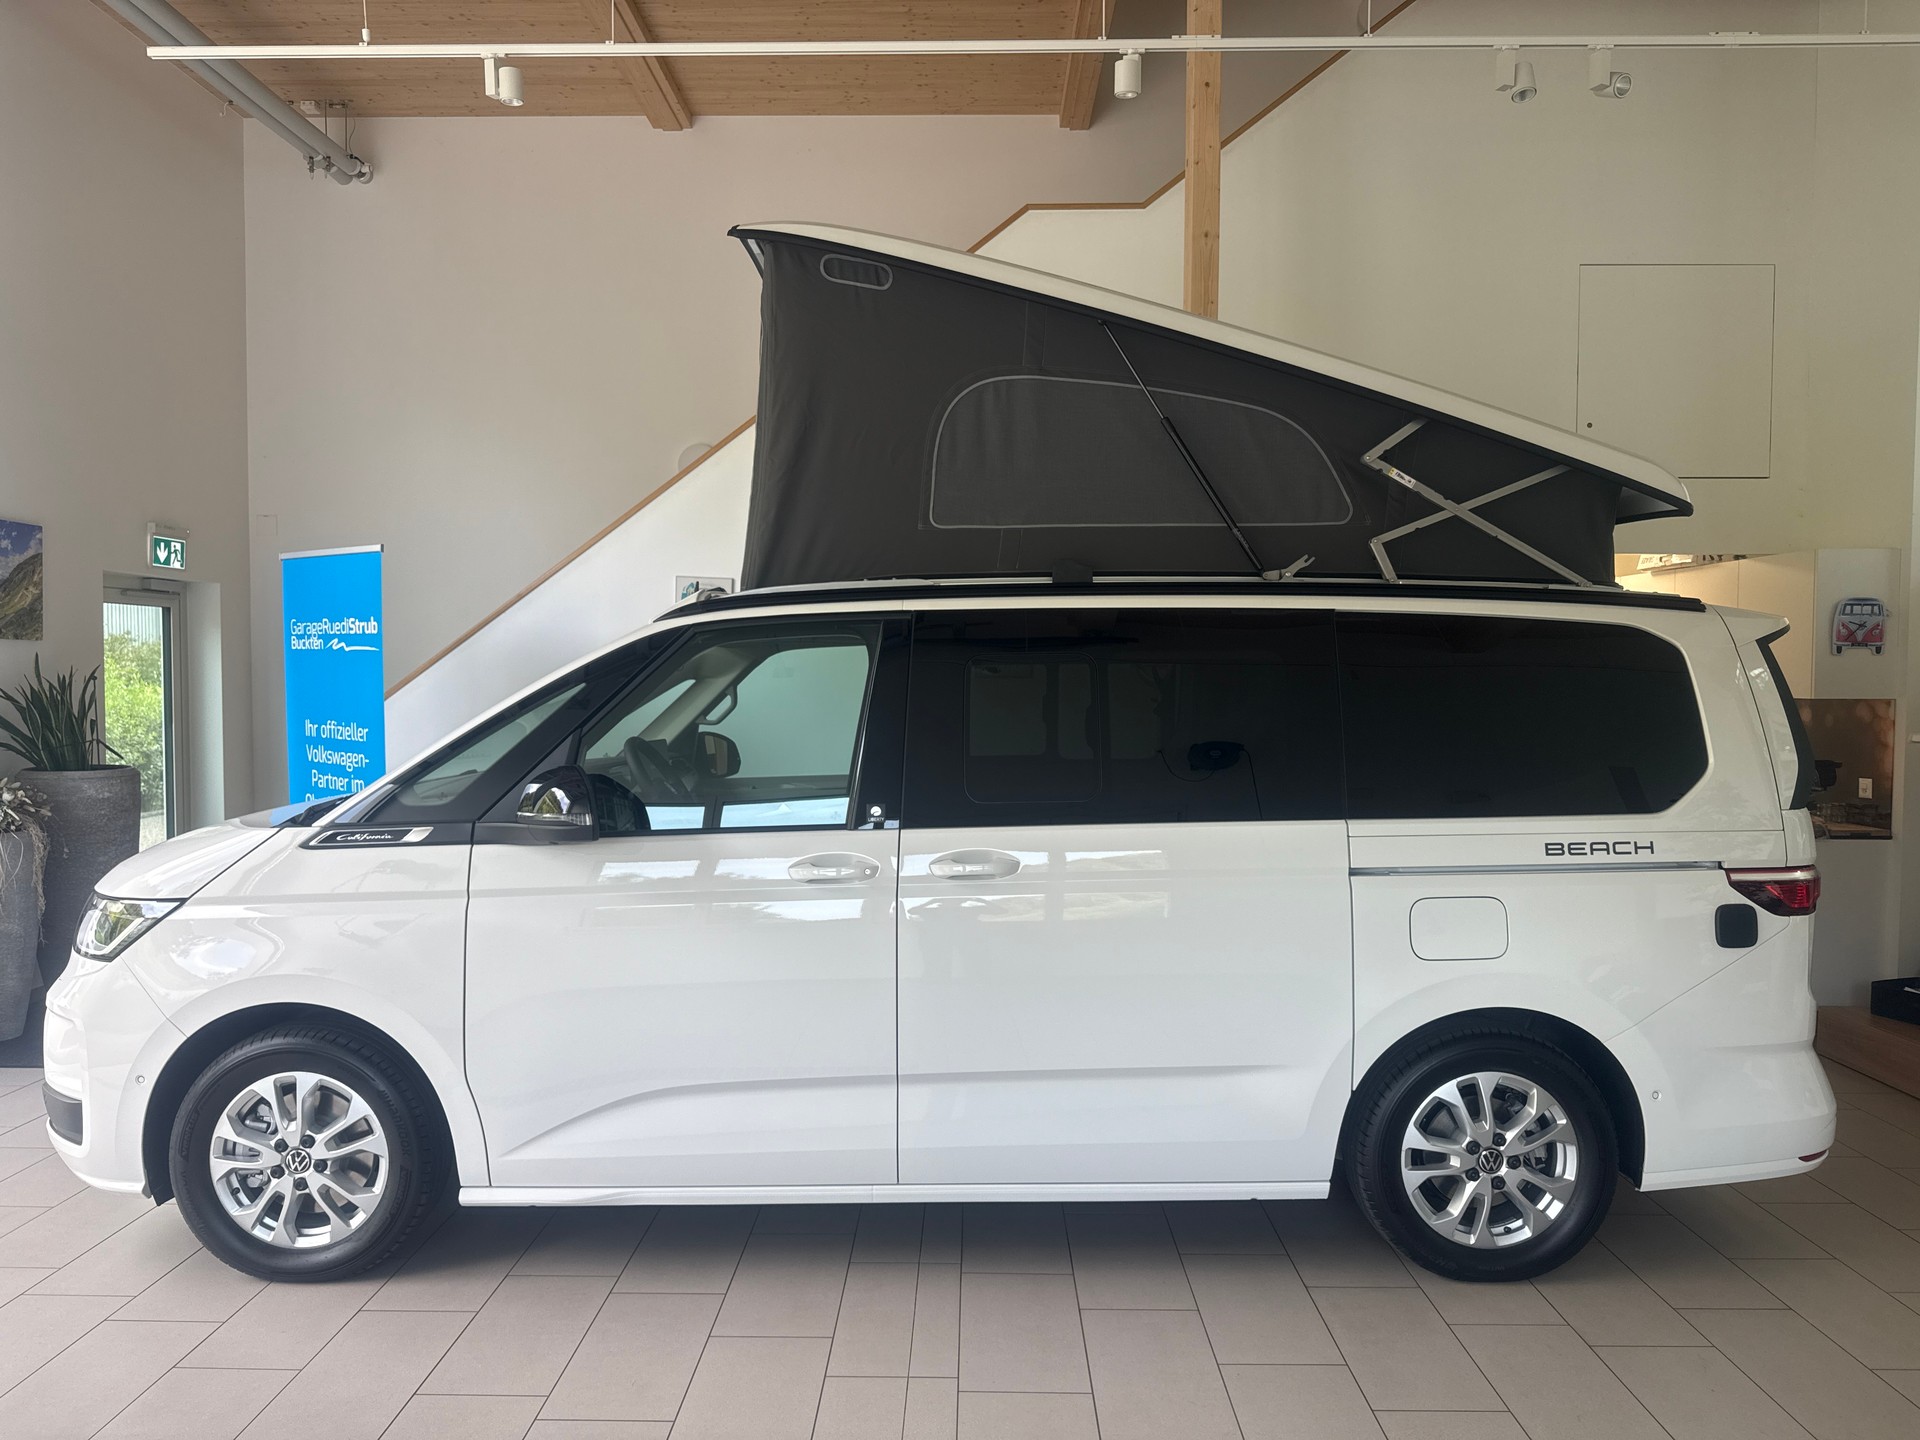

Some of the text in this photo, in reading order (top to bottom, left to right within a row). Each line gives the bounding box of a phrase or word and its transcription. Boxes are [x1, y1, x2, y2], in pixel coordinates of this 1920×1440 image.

[291, 635, 324, 650] Buckten
[305, 719, 369, 742] Ihr offizieller
[305, 744, 370, 772] Volkswagen-
[311, 769, 365, 793] Partner im
[1544, 841, 1655, 856] BEACH
